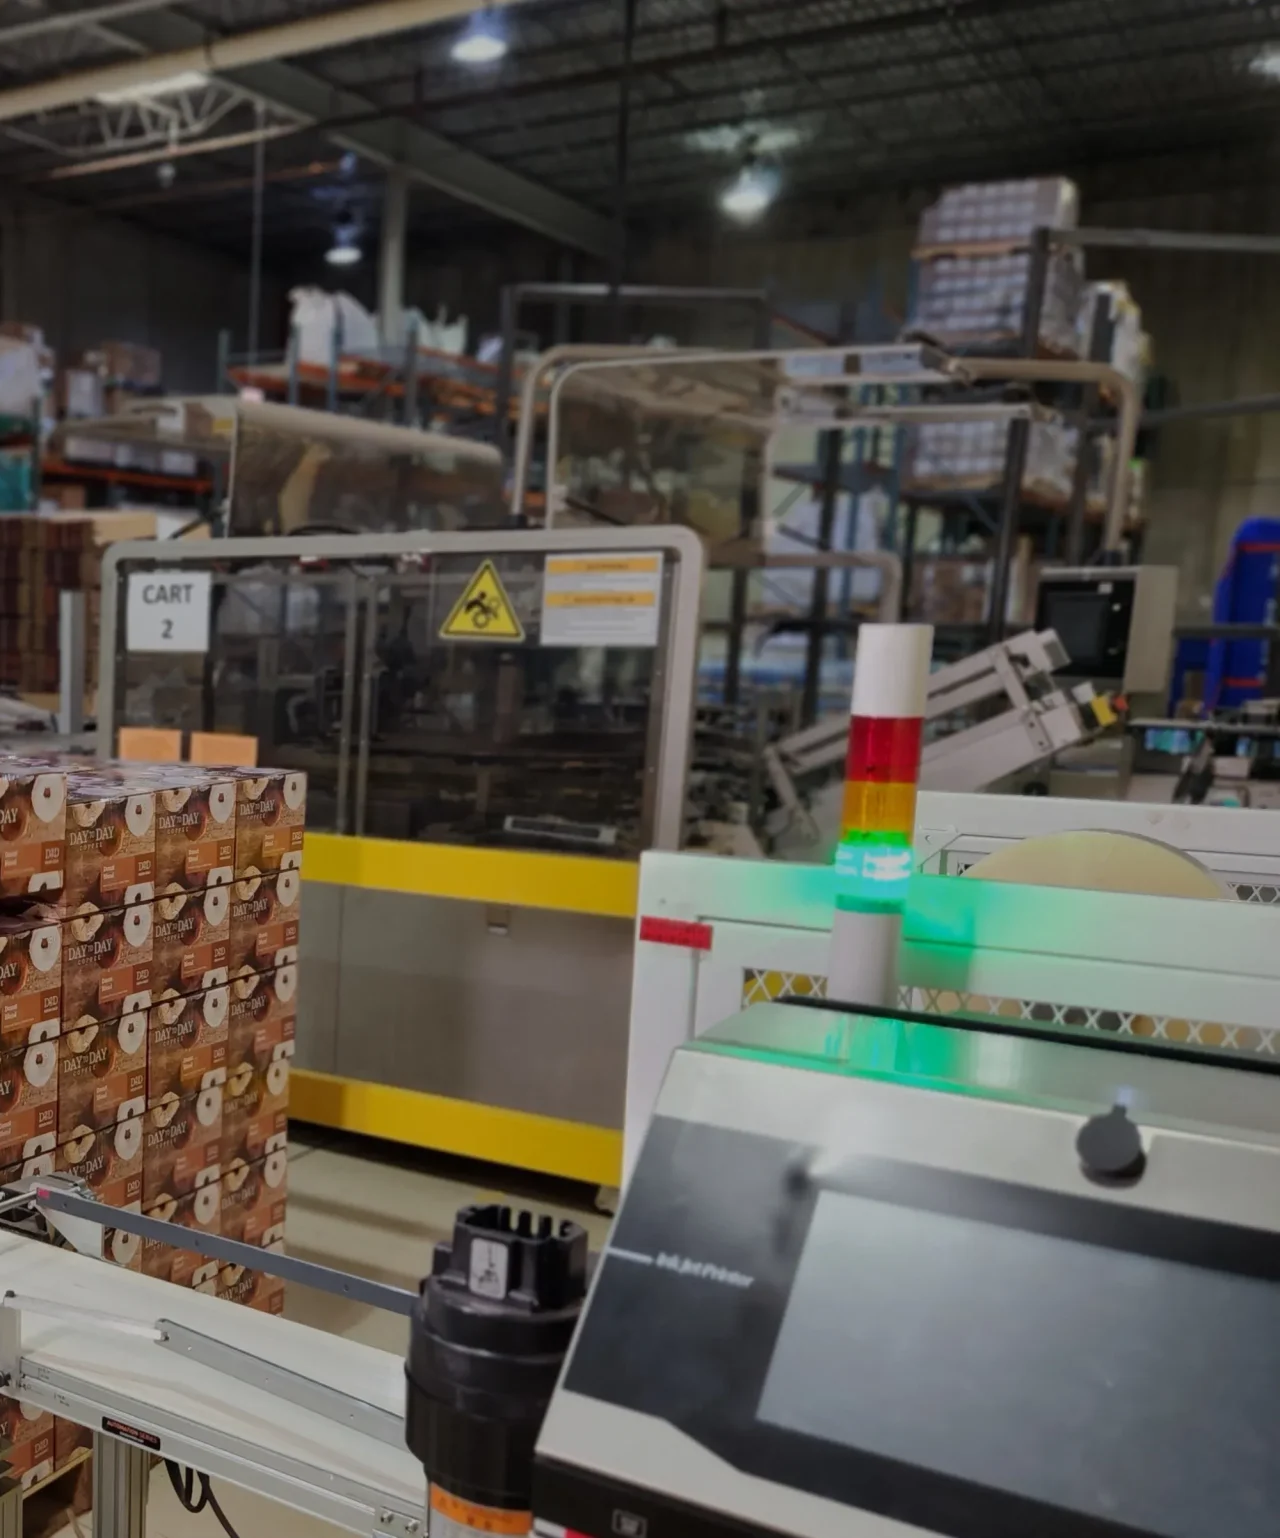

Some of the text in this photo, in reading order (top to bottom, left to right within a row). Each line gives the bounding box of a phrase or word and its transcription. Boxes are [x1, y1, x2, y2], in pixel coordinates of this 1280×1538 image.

[143, 584, 194, 605] CART
[161, 619, 174, 639] 2
[240, 802, 255, 816] DAY
[260, 799, 276, 813] DAY
[158, 815, 176, 829] DAY
[182, 812, 200, 826] DAY
[69, 831, 89, 846] DAY
[95, 826, 115, 842] DAY
[233, 904, 248, 917] DAY
[253, 898, 268, 912] DAY
[155, 923, 171, 938] DAY
[177, 918, 195, 933] DAY
[68, 945, 87, 962] DAY
[94, 938, 114, 956] DAY
[155, 1029, 171, 1044] DAY
[177, 1020, 194, 1037] DAY
[63, 1056, 83, 1073] DAY
[89, 1047, 108, 1065] DAY
[147, 1130, 164, 1147] DAY
[170, 1121, 187, 1139] DAY
[86, 1155, 104, 1174] DAY
